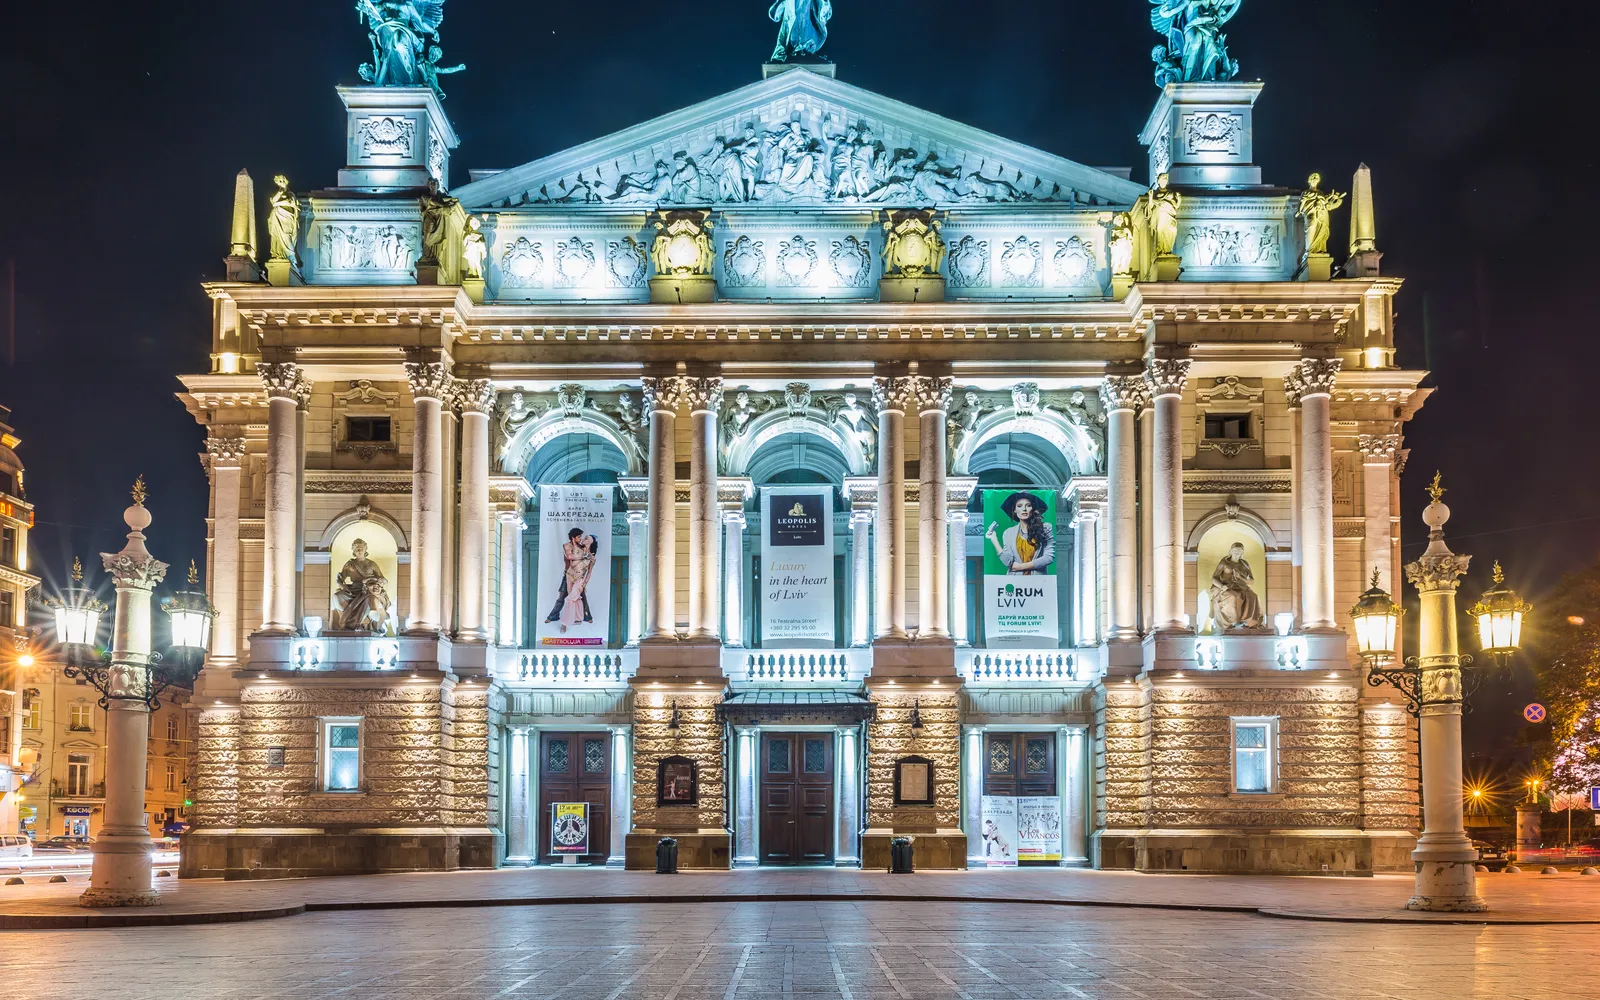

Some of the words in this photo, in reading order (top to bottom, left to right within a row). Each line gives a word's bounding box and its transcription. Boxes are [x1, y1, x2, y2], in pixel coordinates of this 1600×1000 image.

[770, 562, 806, 573] Luxury
[770, 576, 779, 585] in
[783, 576, 798, 585] the
[801, 576, 827, 585] heart
[770, 589, 782, 601] of
[783, 590, 808, 599] Lviv
[998, 584, 1043, 597] FORUM
[998, 598, 1026, 607] LVIV
[1018, 830, 1059, 839] VIVANCOS
